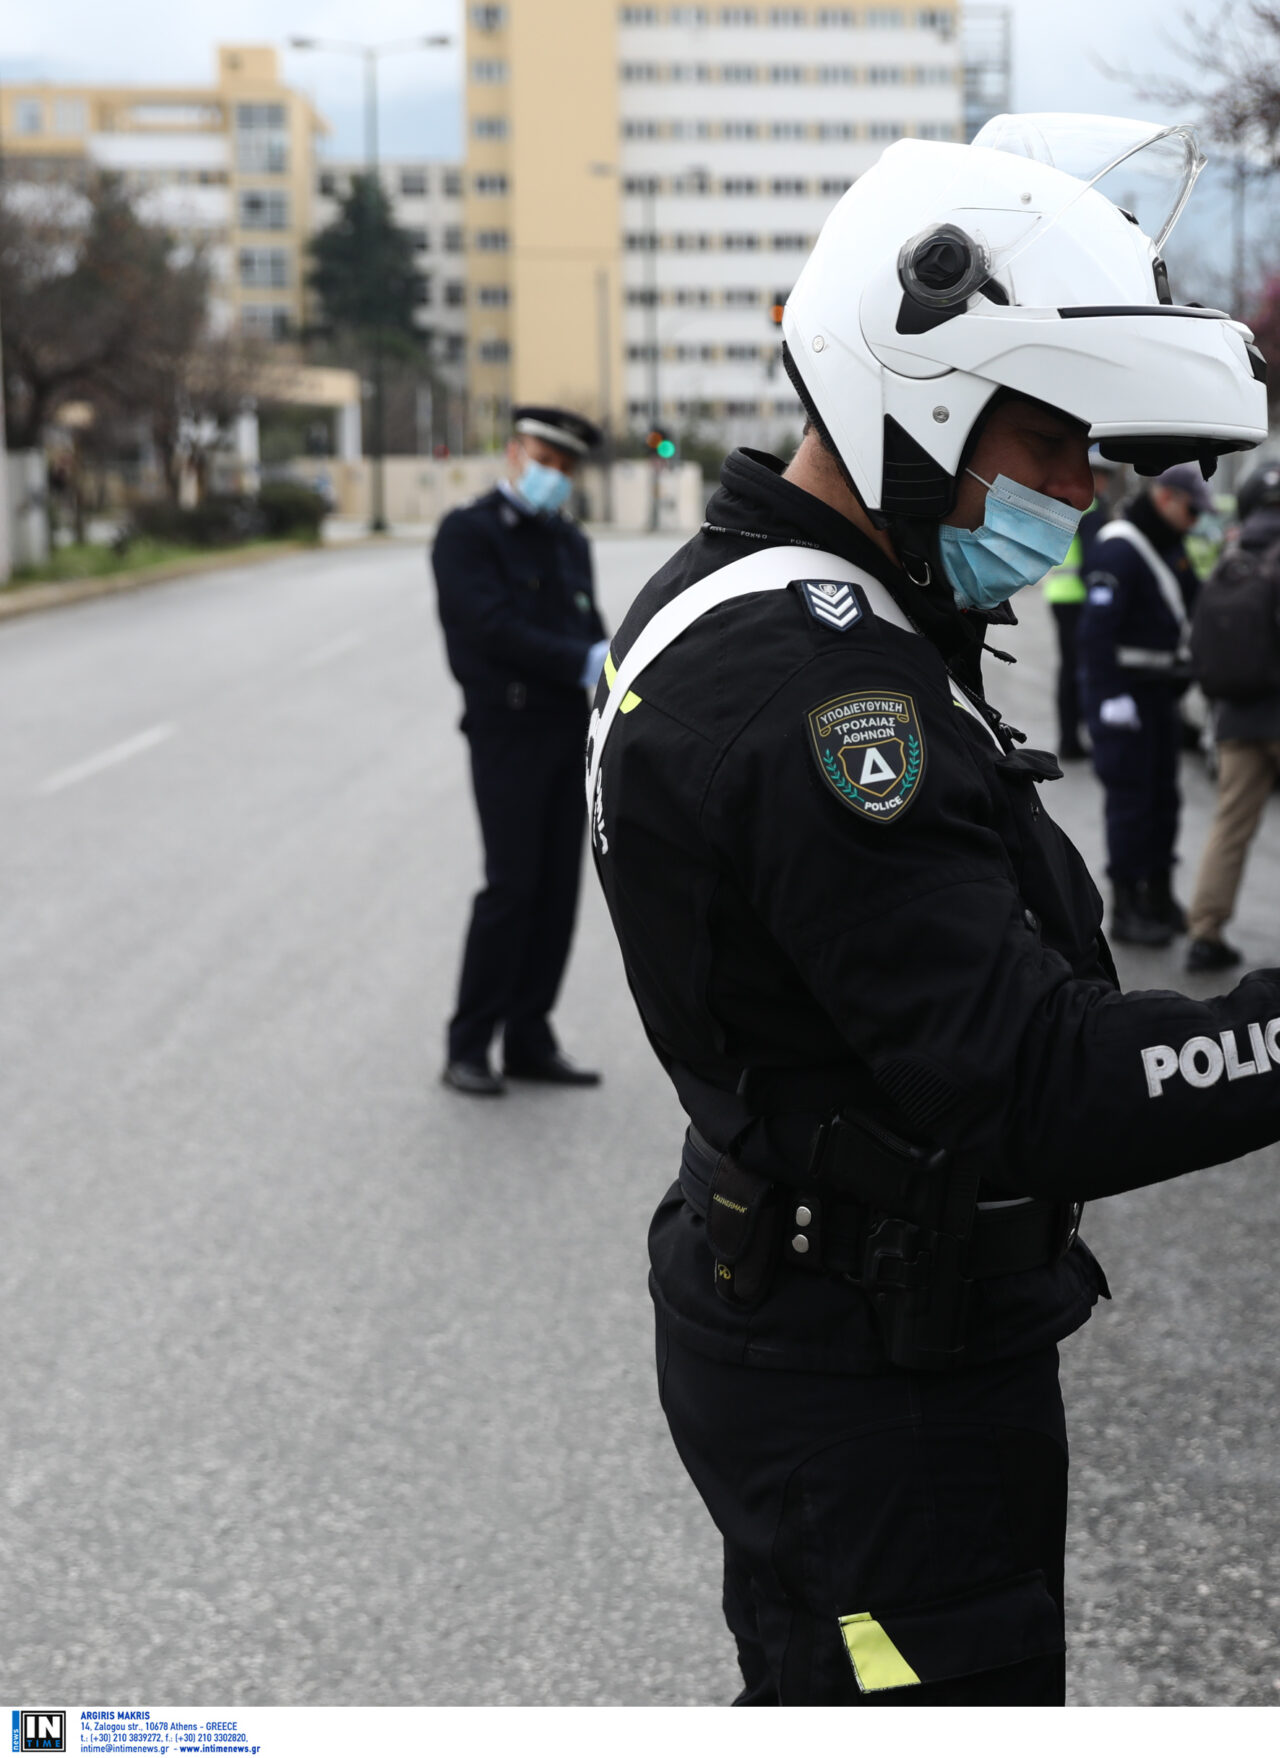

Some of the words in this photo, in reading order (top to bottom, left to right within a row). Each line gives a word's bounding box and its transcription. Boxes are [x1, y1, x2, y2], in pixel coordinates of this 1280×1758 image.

[820, 701, 903, 725] ΥΠΟΔΙΕΥΘΥΝΣΗ
[834, 717, 896, 736] ΤΡΟΧΑΙΑΣ
[843, 728, 895, 745] ΑΘΗΝΩΝ
[864, 795, 903, 812] POLICE
